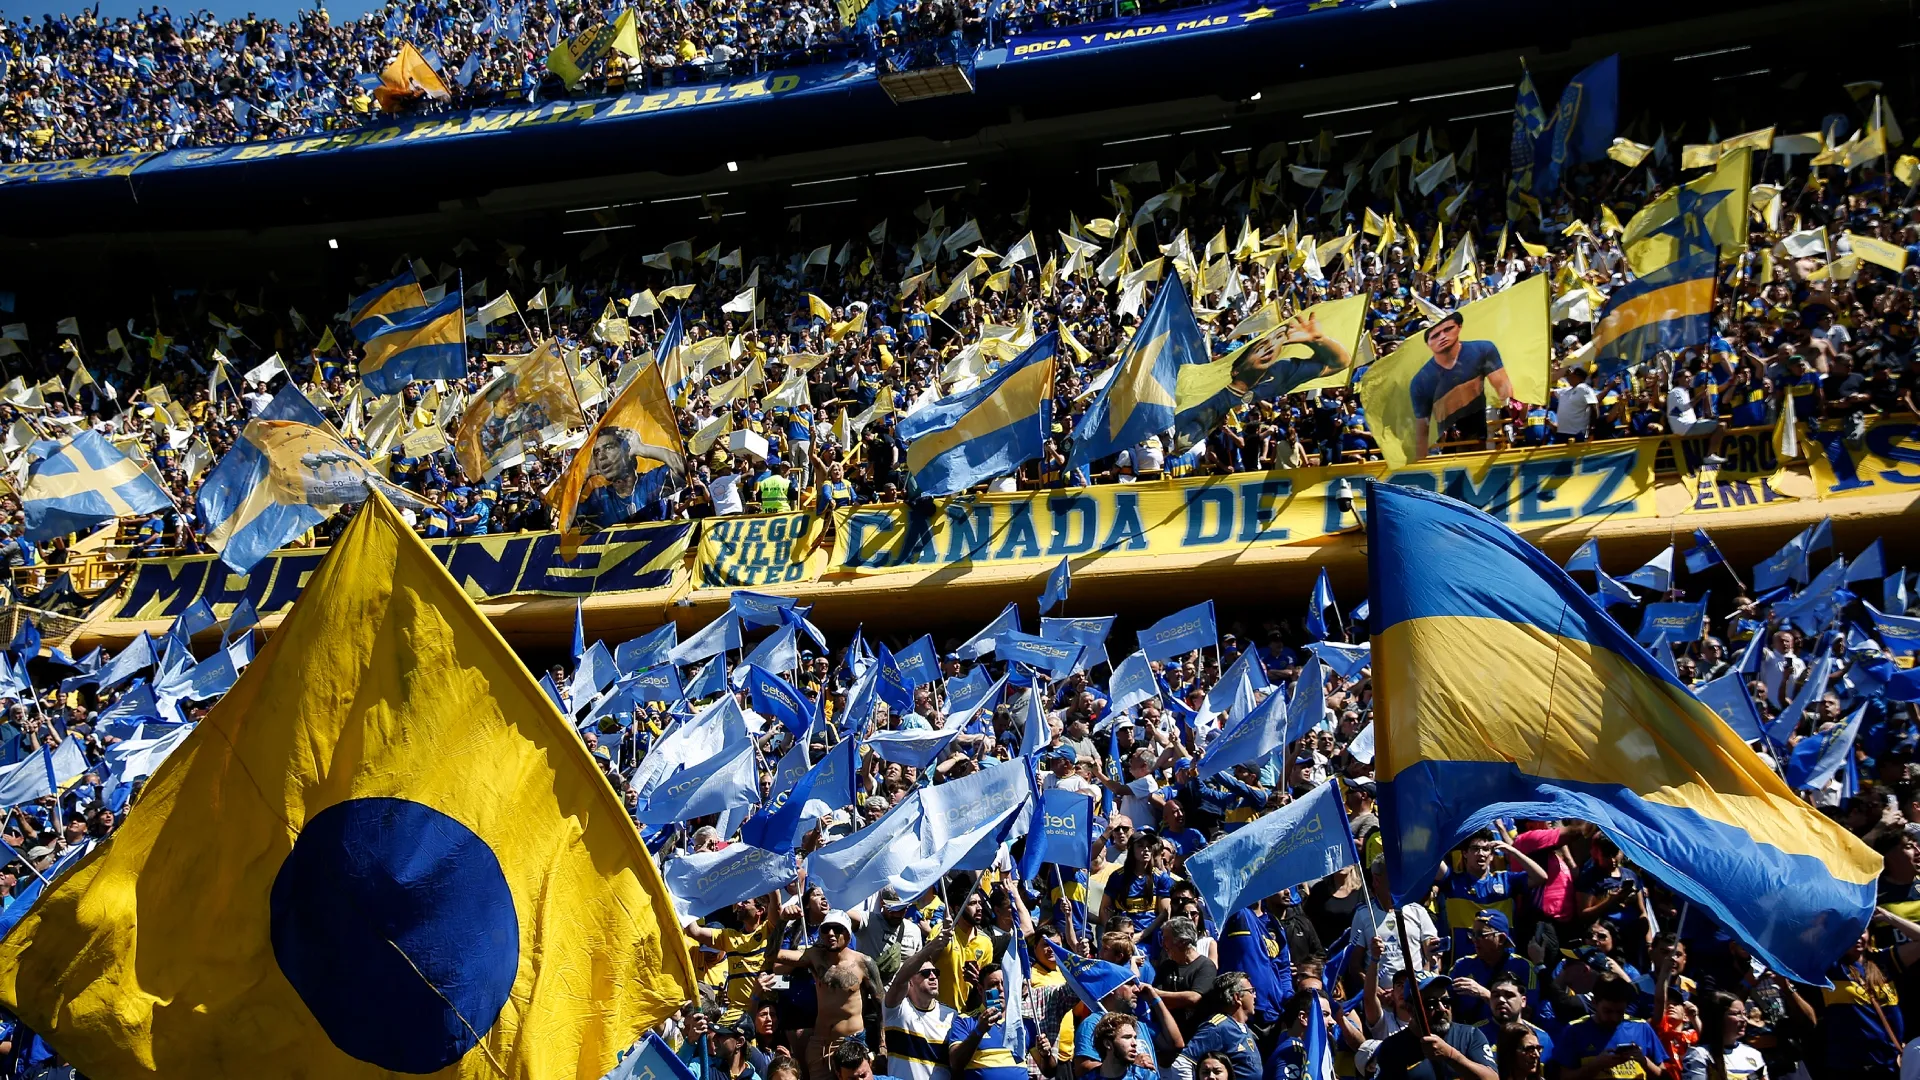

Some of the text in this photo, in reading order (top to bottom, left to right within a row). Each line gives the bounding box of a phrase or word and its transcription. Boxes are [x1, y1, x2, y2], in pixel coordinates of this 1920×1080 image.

[1014, 15, 1229, 56] BOCA Y NADA MÁS
[232, 126, 402, 161] BARRIO
[403, 104, 597, 142] FAMILIA
[710, 514, 811, 542] DIEGO
[1180, 480, 1293, 548] DE
[702, 562, 804, 587] MATEO
[761, 681, 799, 711] betsson
